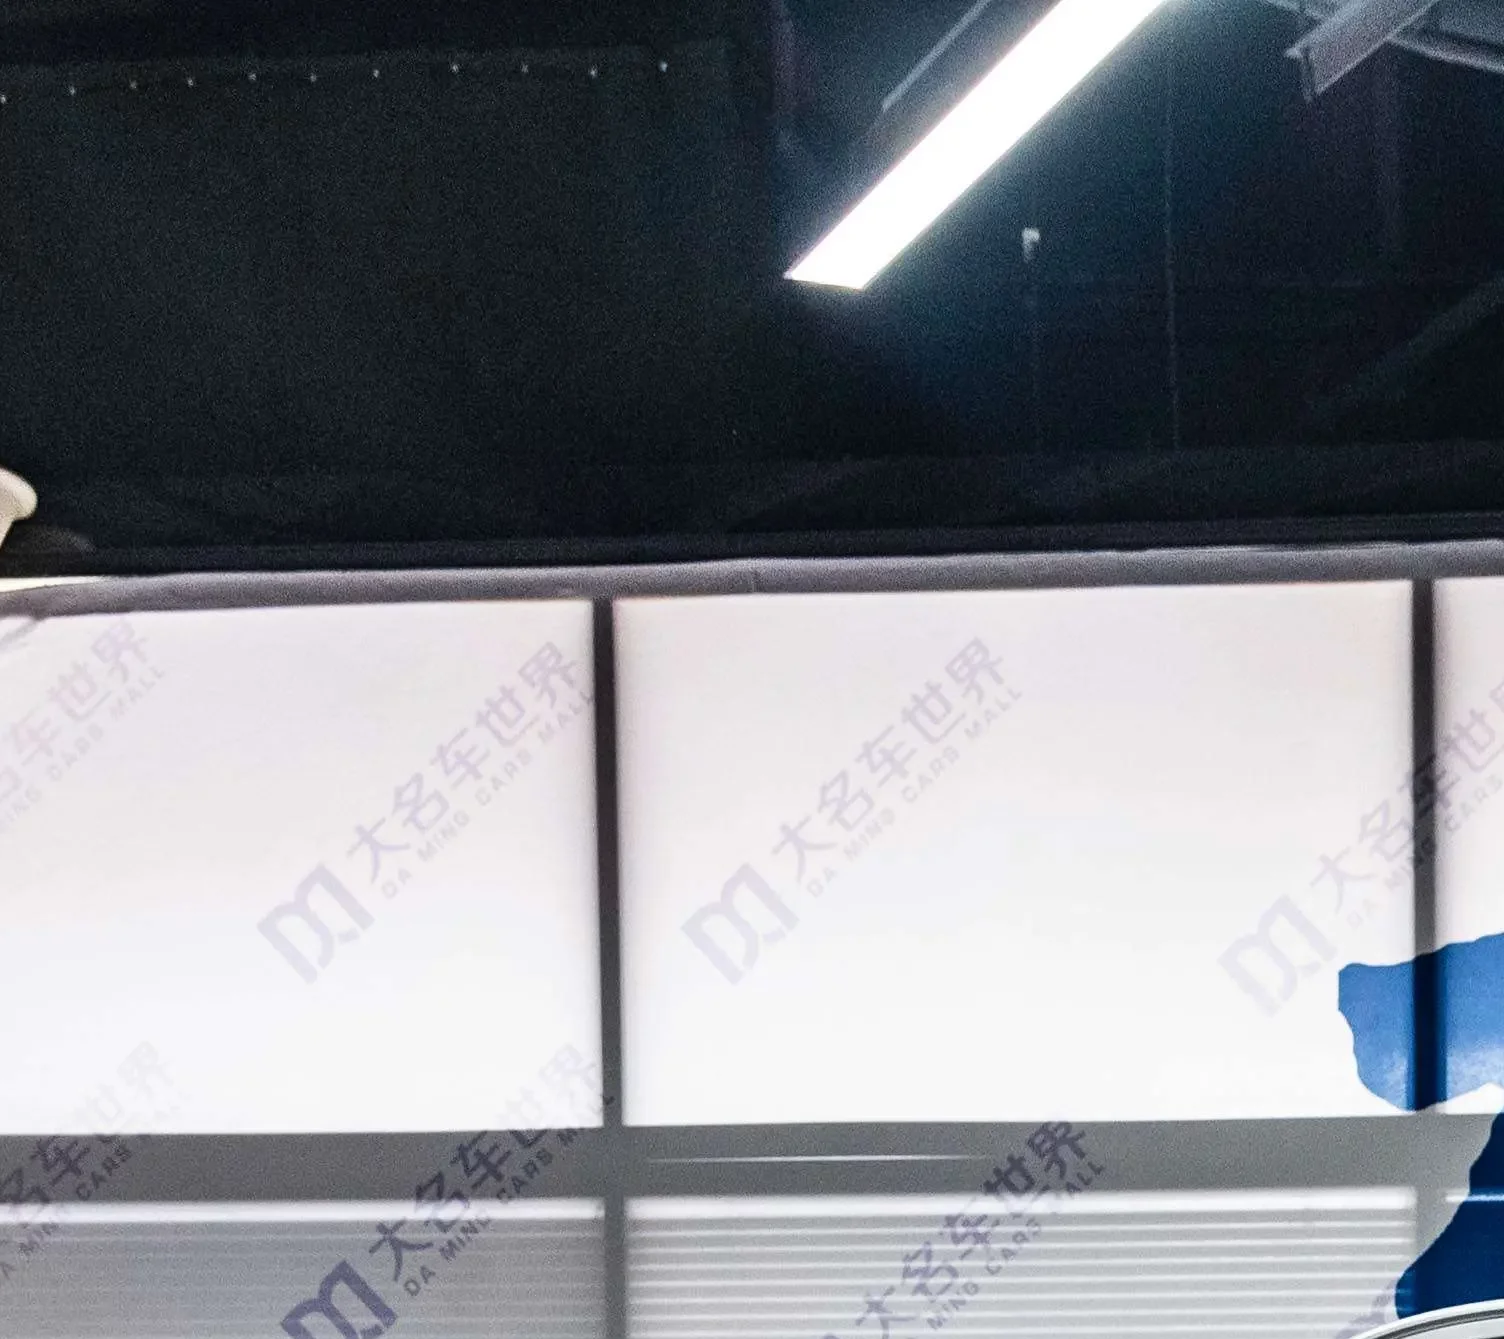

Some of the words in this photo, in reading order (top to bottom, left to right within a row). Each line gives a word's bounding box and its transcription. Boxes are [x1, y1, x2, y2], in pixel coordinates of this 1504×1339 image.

[350, 644, 577, 881] 大名车世界
[775, 641, 1007, 881] 大名车世界
